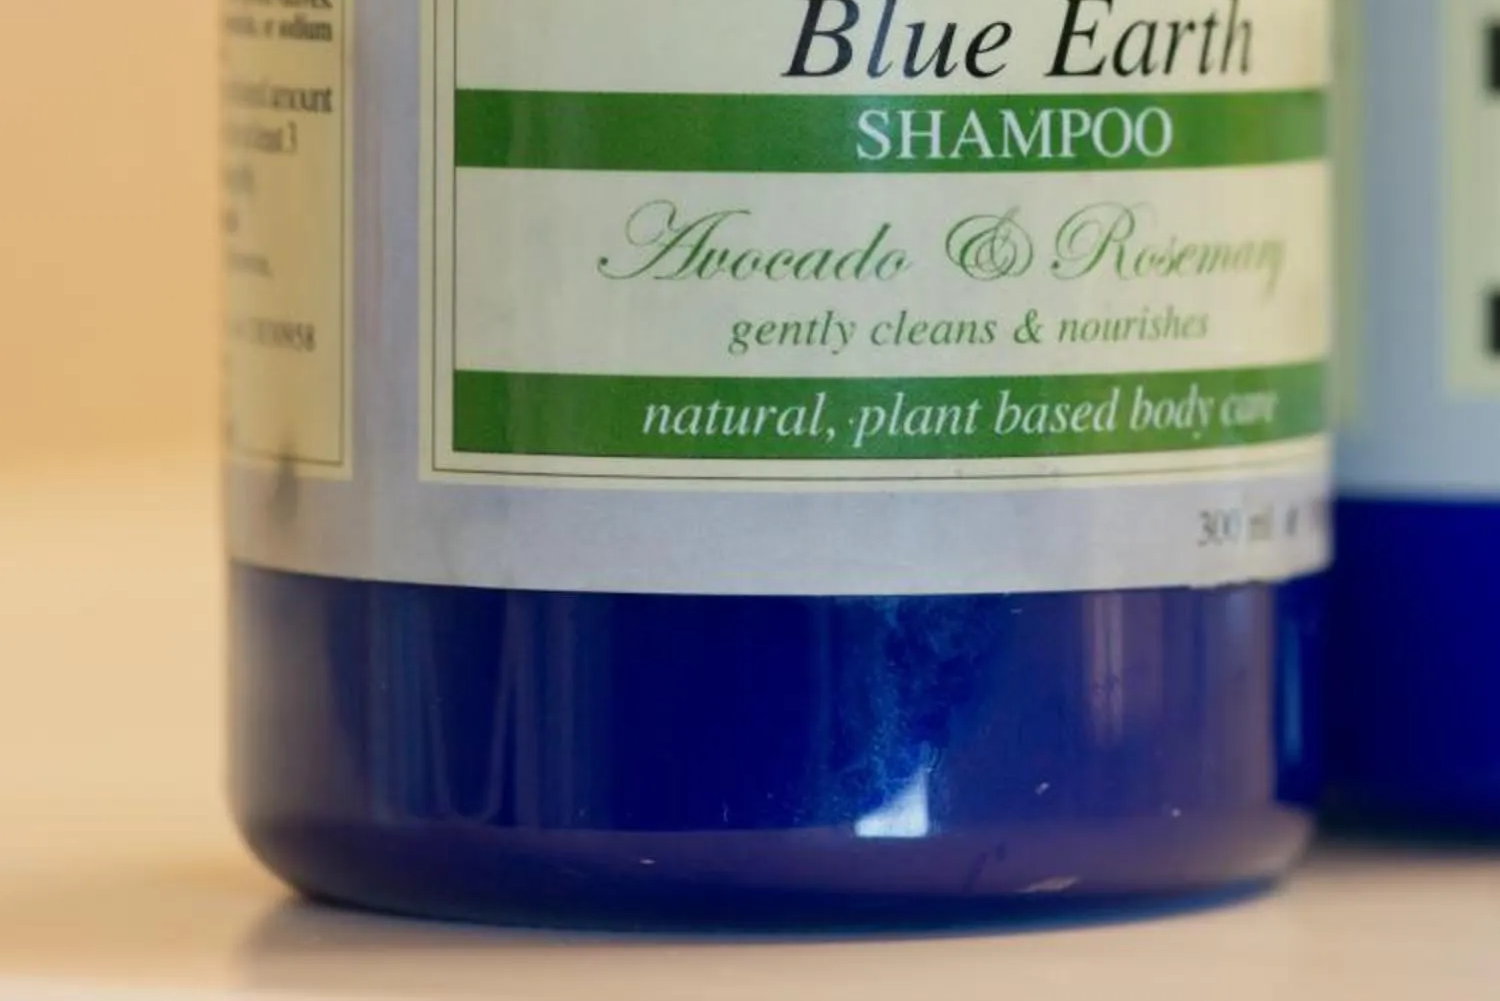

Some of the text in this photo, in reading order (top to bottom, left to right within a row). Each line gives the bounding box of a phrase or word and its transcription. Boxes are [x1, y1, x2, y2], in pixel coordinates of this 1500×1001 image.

[855, 107, 1174, 160] SHAMPOO
[597, 198, 1287, 301] Avocado & Rosemary
[728, 304, 1211, 355] gently cleans & nourishes
[642, 383, 1280, 448] natural, plant based body care
